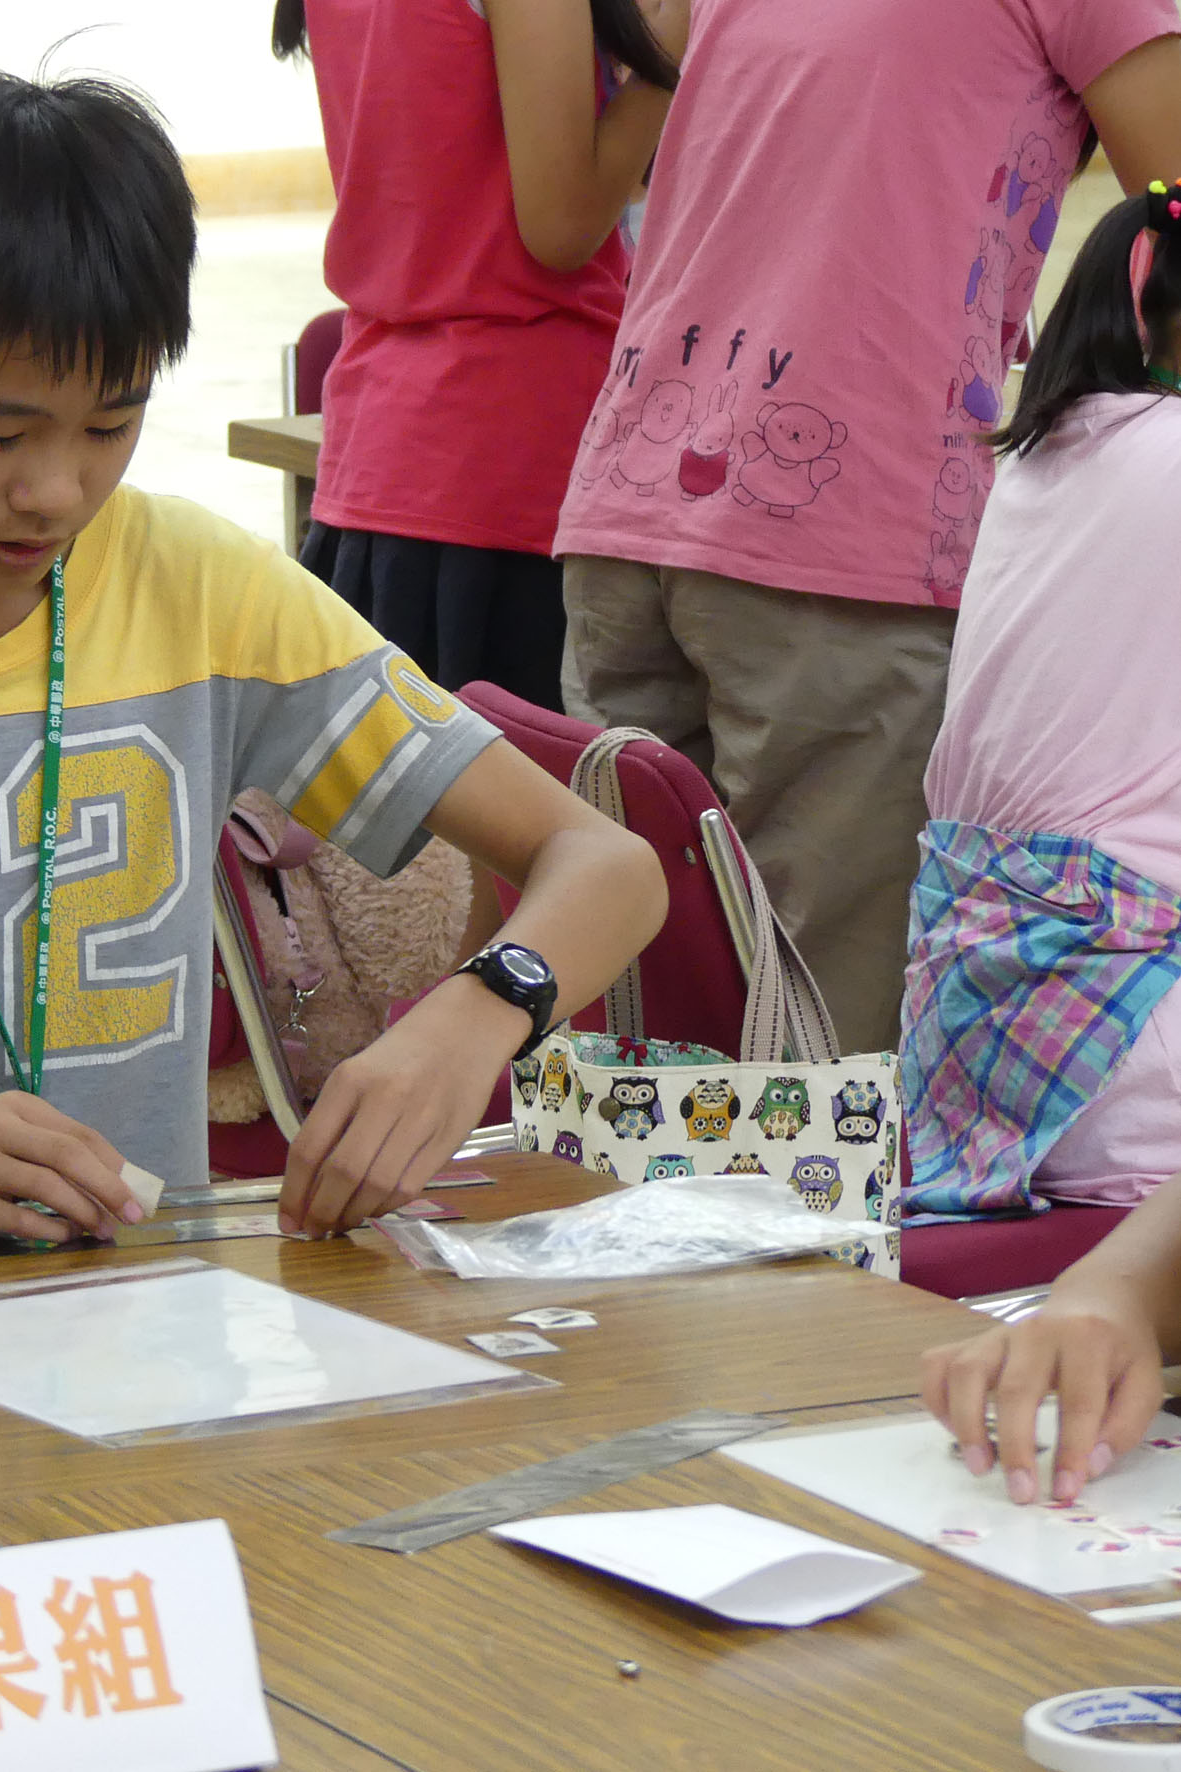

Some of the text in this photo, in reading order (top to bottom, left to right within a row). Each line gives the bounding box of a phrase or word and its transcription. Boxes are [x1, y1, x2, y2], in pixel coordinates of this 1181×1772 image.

[54, 594, 65, 647] POSTAL
[42, 806, 58, 910] POSTAL R.O.C.
